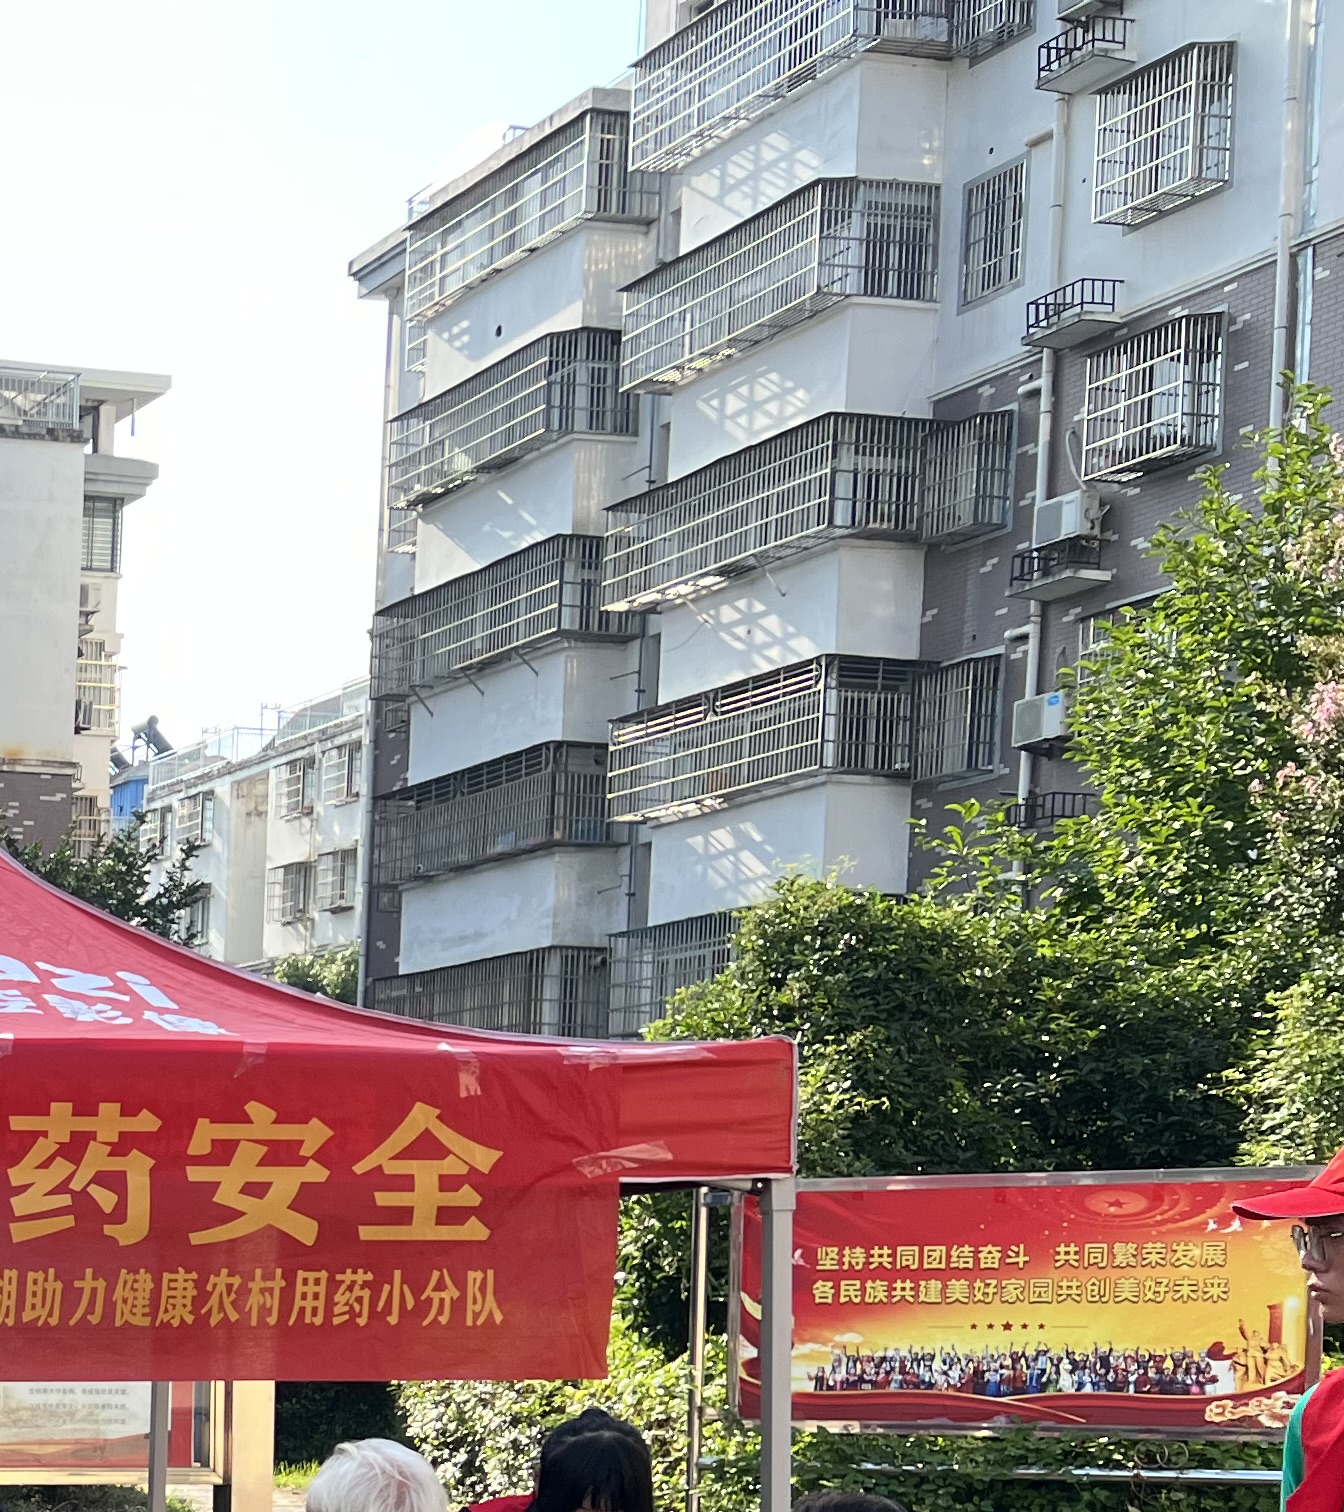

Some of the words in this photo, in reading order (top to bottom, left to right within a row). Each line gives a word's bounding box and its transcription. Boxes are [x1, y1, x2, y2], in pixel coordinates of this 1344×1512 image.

[816, 1245, 1030, 1271] 坚持共同团结奋斗
[1054, 1240, 1228, 1269] 共同繁荣发展
[812, 1275, 1230, 1305] 各民族共建美好家园共创美好未来
